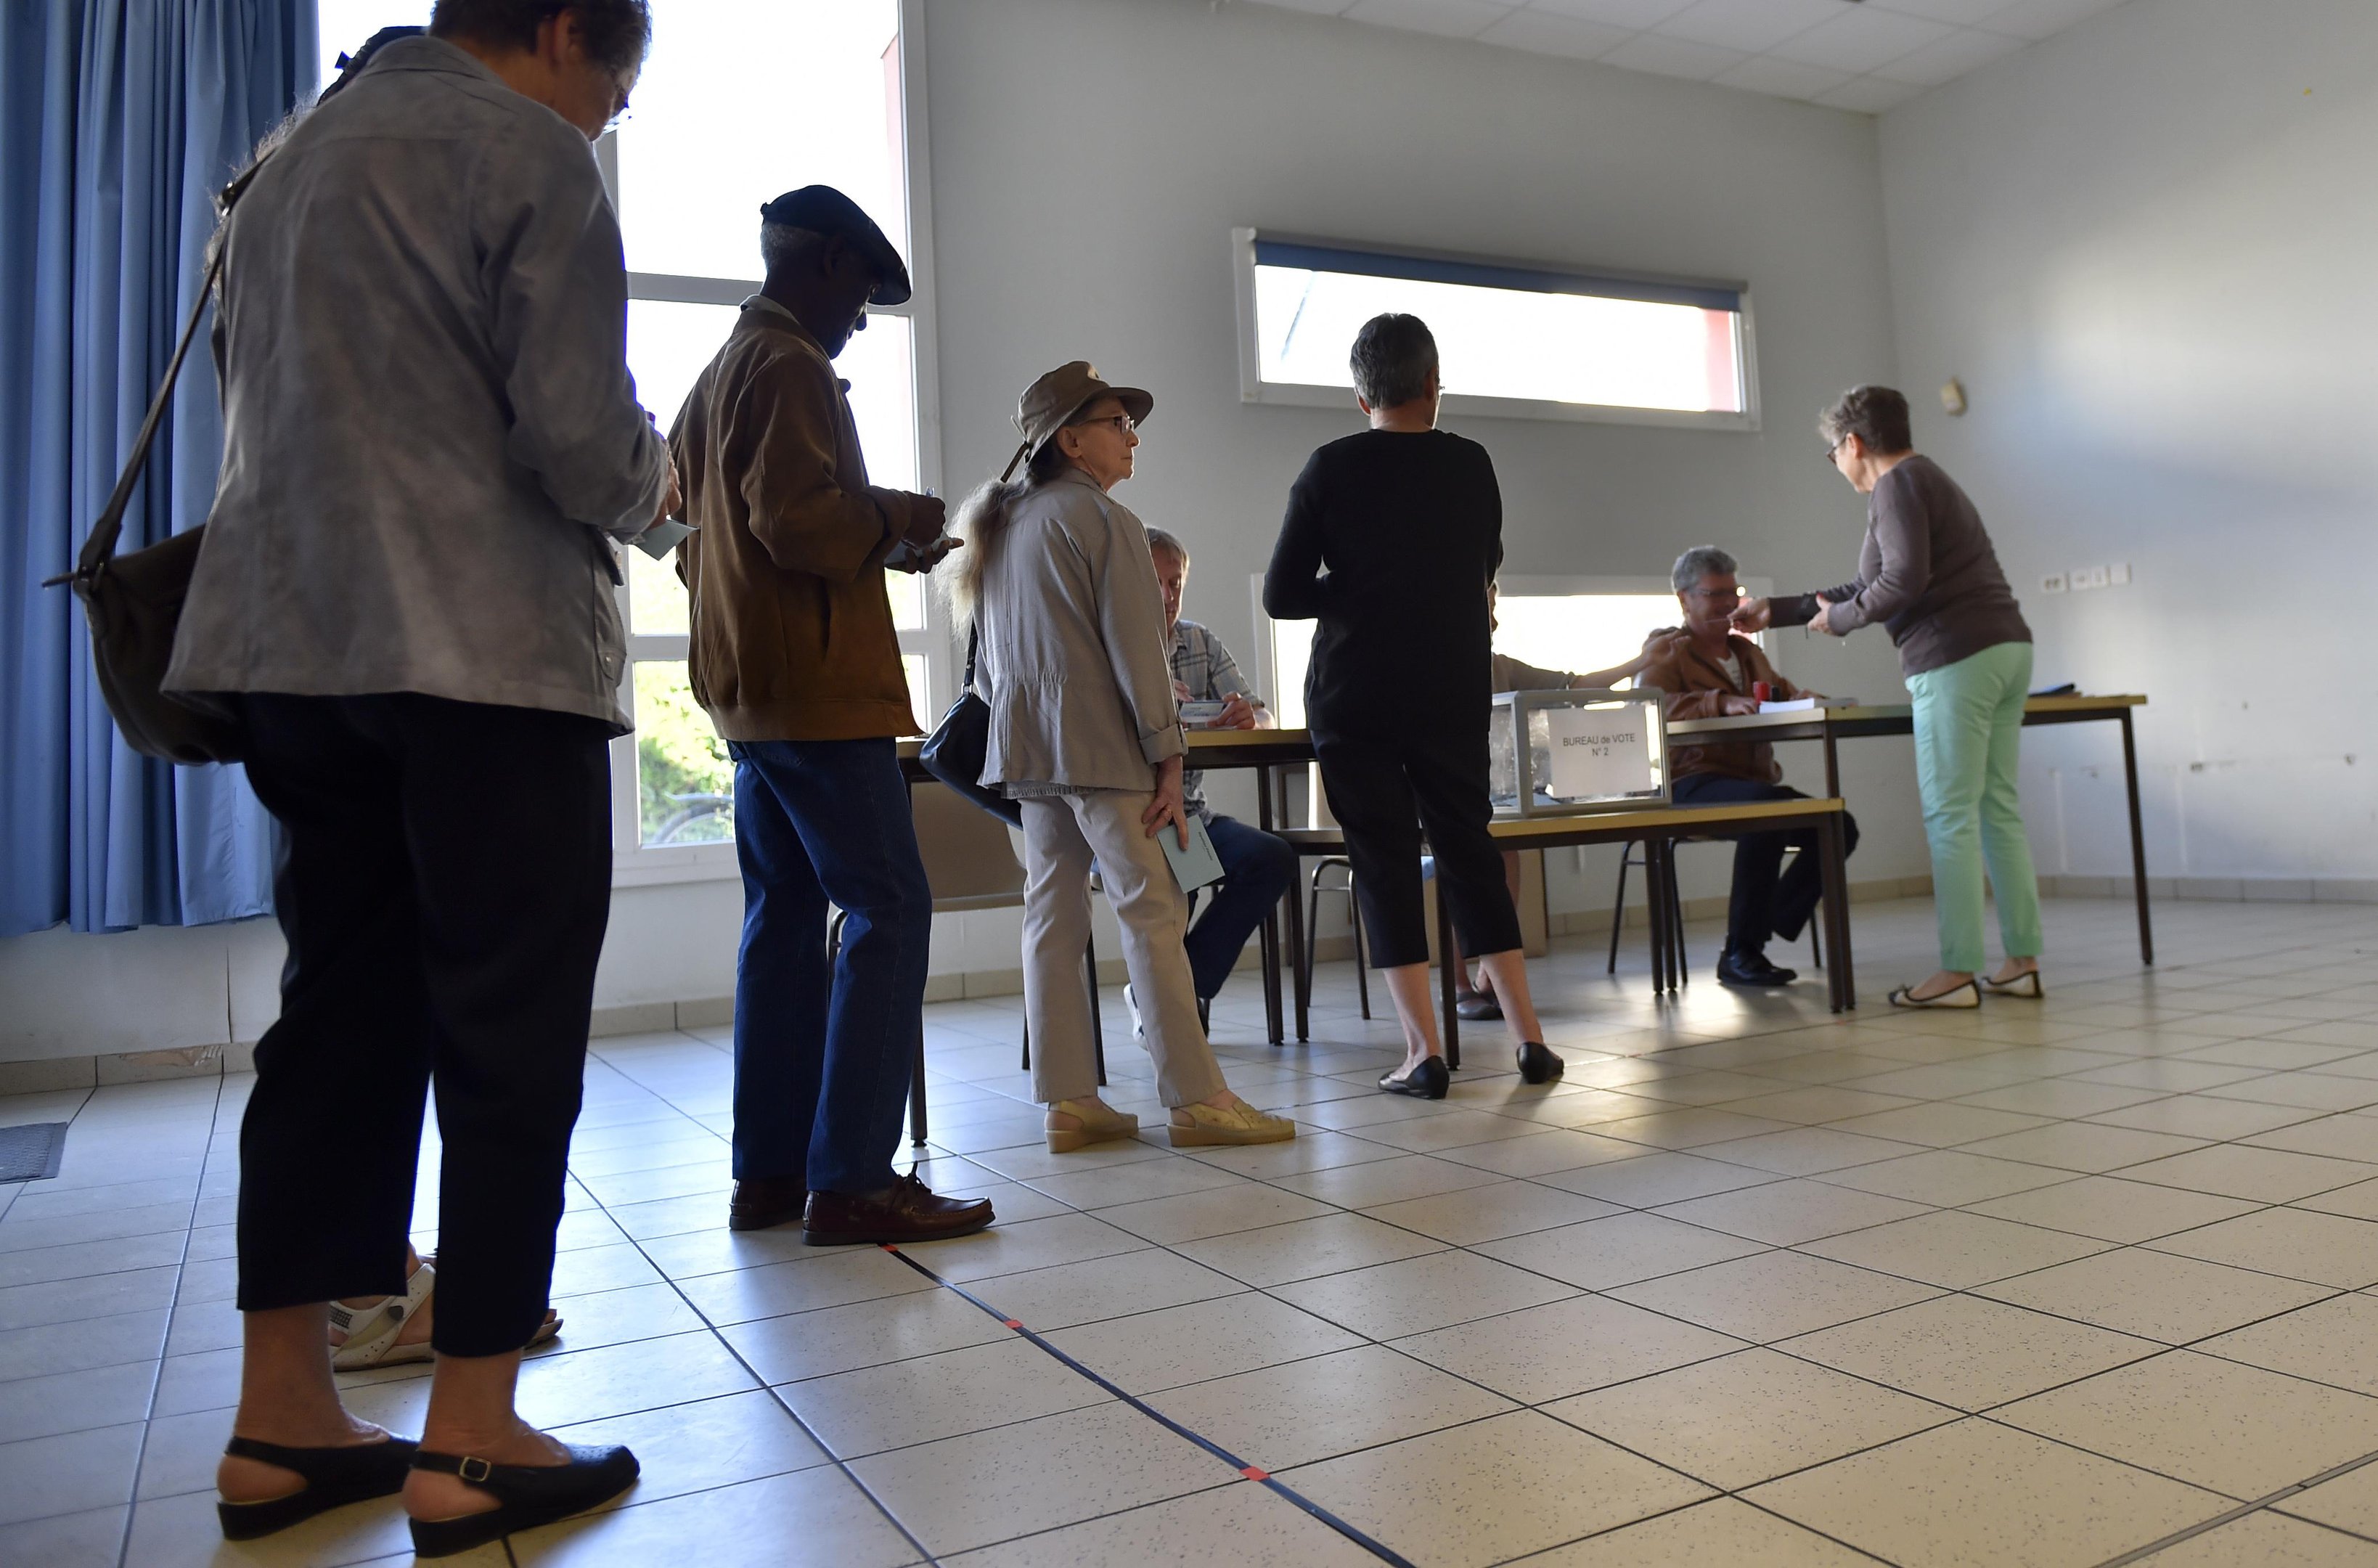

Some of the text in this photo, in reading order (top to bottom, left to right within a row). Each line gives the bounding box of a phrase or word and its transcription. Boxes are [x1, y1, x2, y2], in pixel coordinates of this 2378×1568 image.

[1563, 735, 1599, 746] BUREAU
[1611, 732, 1635, 743] VOTE
[1603, 747, 1609, 756] 2
